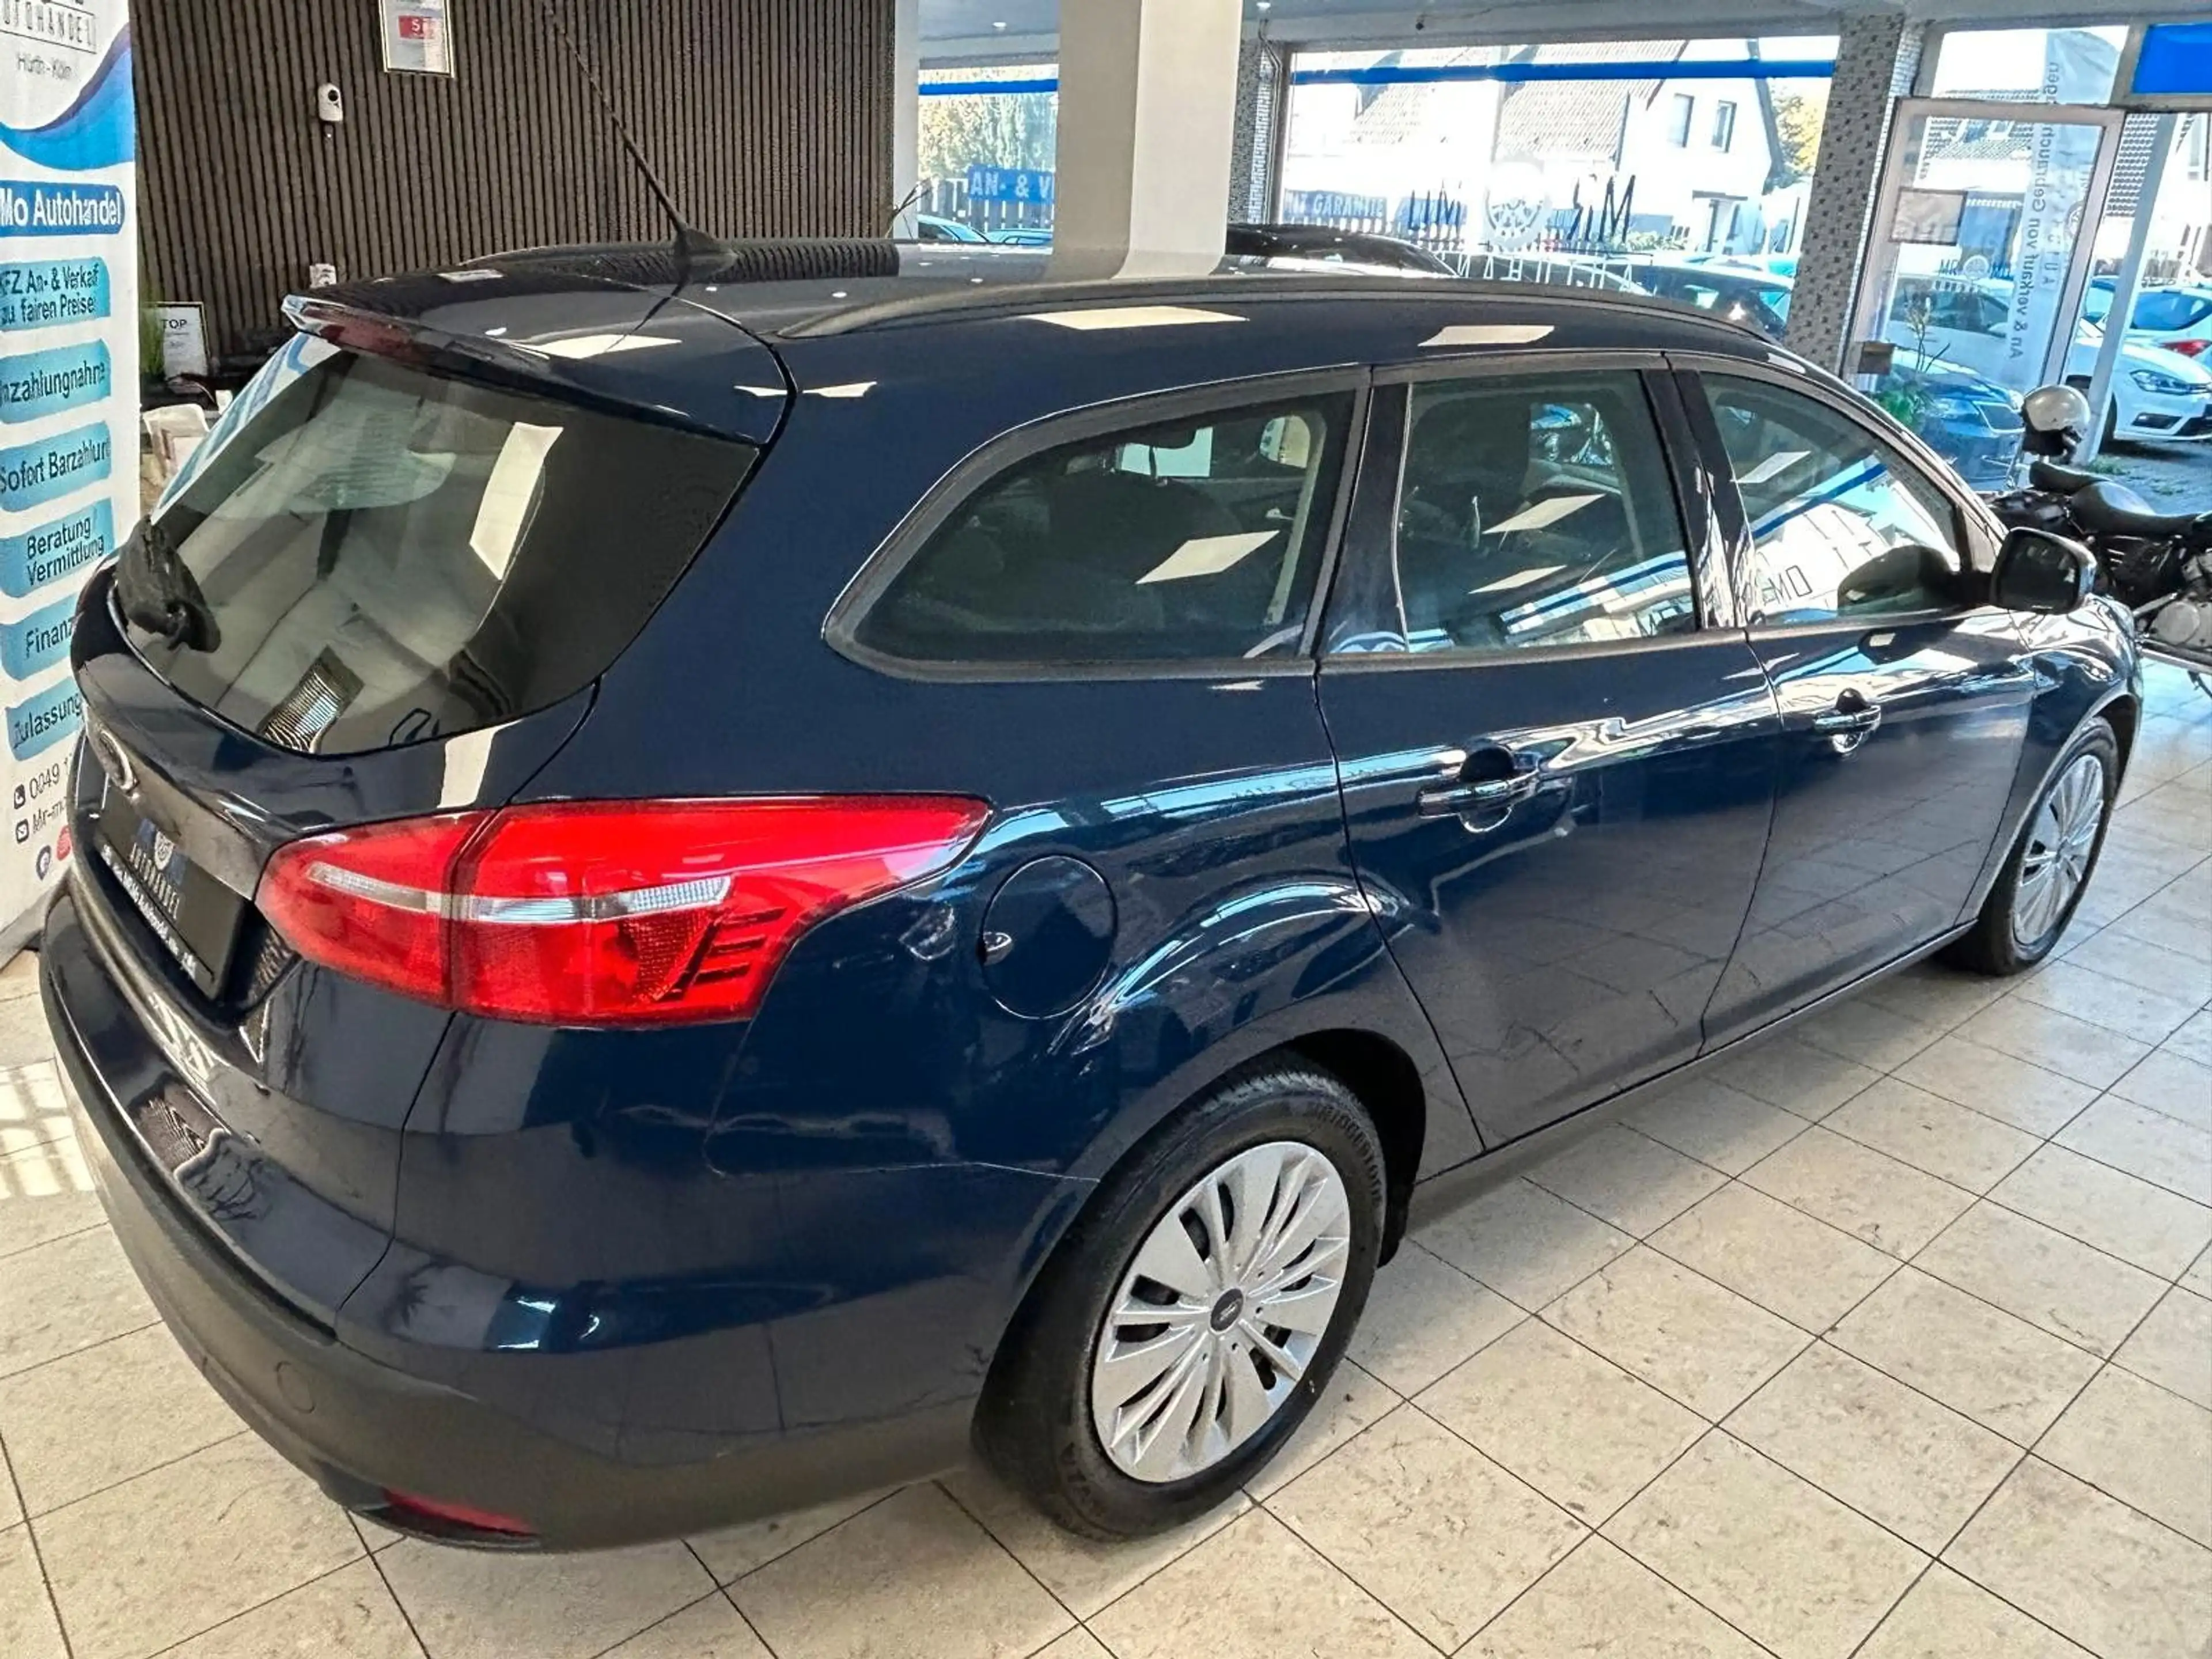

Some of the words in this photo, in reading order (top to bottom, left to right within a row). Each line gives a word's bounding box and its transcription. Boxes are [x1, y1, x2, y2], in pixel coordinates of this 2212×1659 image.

[0, 188, 28, 226] Mo
[33, 189, 122, 226] Autohandel
[161, 319, 188, 329] TOP
[27, 517, 92, 560] Beratung
[27, 534, 104, 586] Vermittlung
[29, 763, 60, 800] 0049
